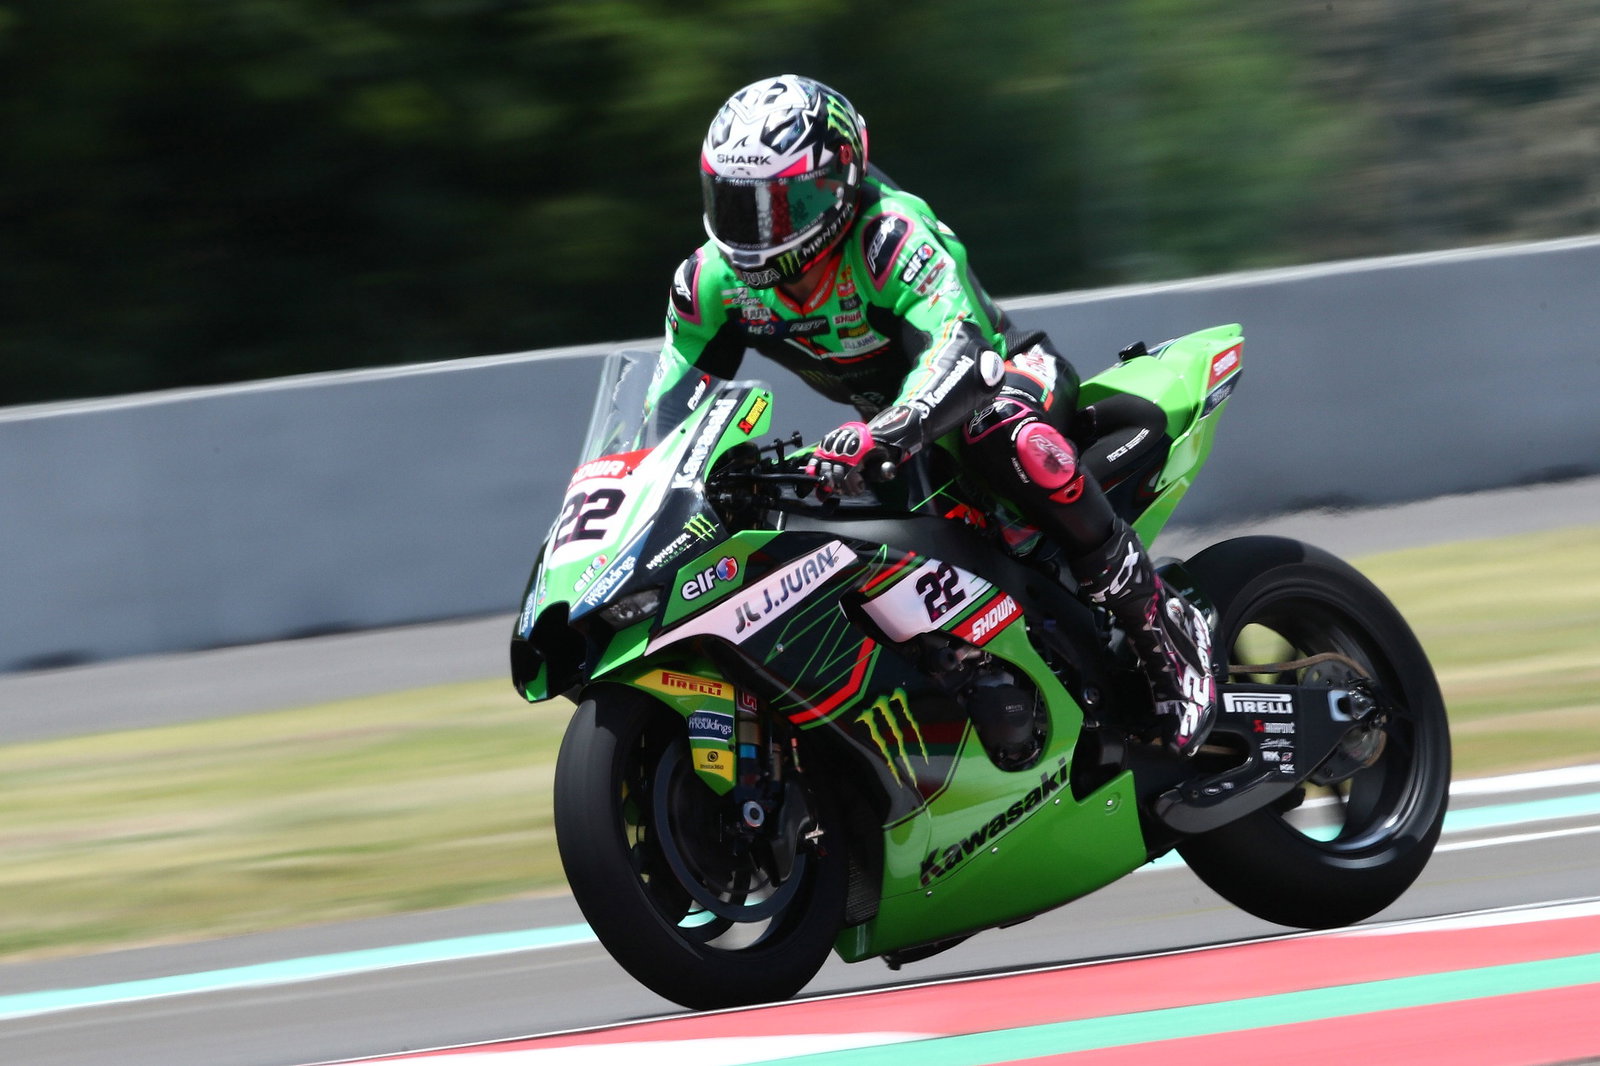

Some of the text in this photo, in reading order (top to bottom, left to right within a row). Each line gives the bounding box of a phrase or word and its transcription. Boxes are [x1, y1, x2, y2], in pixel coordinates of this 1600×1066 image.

[716, 153, 772, 166] SHARK
[902, 254, 923, 283] elf
[670, 398, 738, 489] Kawasaki
[552, 488, 627, 553] 22
[645, 532, 691, 571] MONSTER
[573, 565, 597, 593] elf
[681, 567, 716, 601] elf
[763, 545, 836, 615] J.JUAN
[915, 561, 967, 624] 22
[971, 594, 1018, 643] SHOWA
[661, 671, 723, 697] PIRELLI
[1222, 692, 1294, 714] PIRELLI
[919, 756, 1068, 888] Kawasaki
